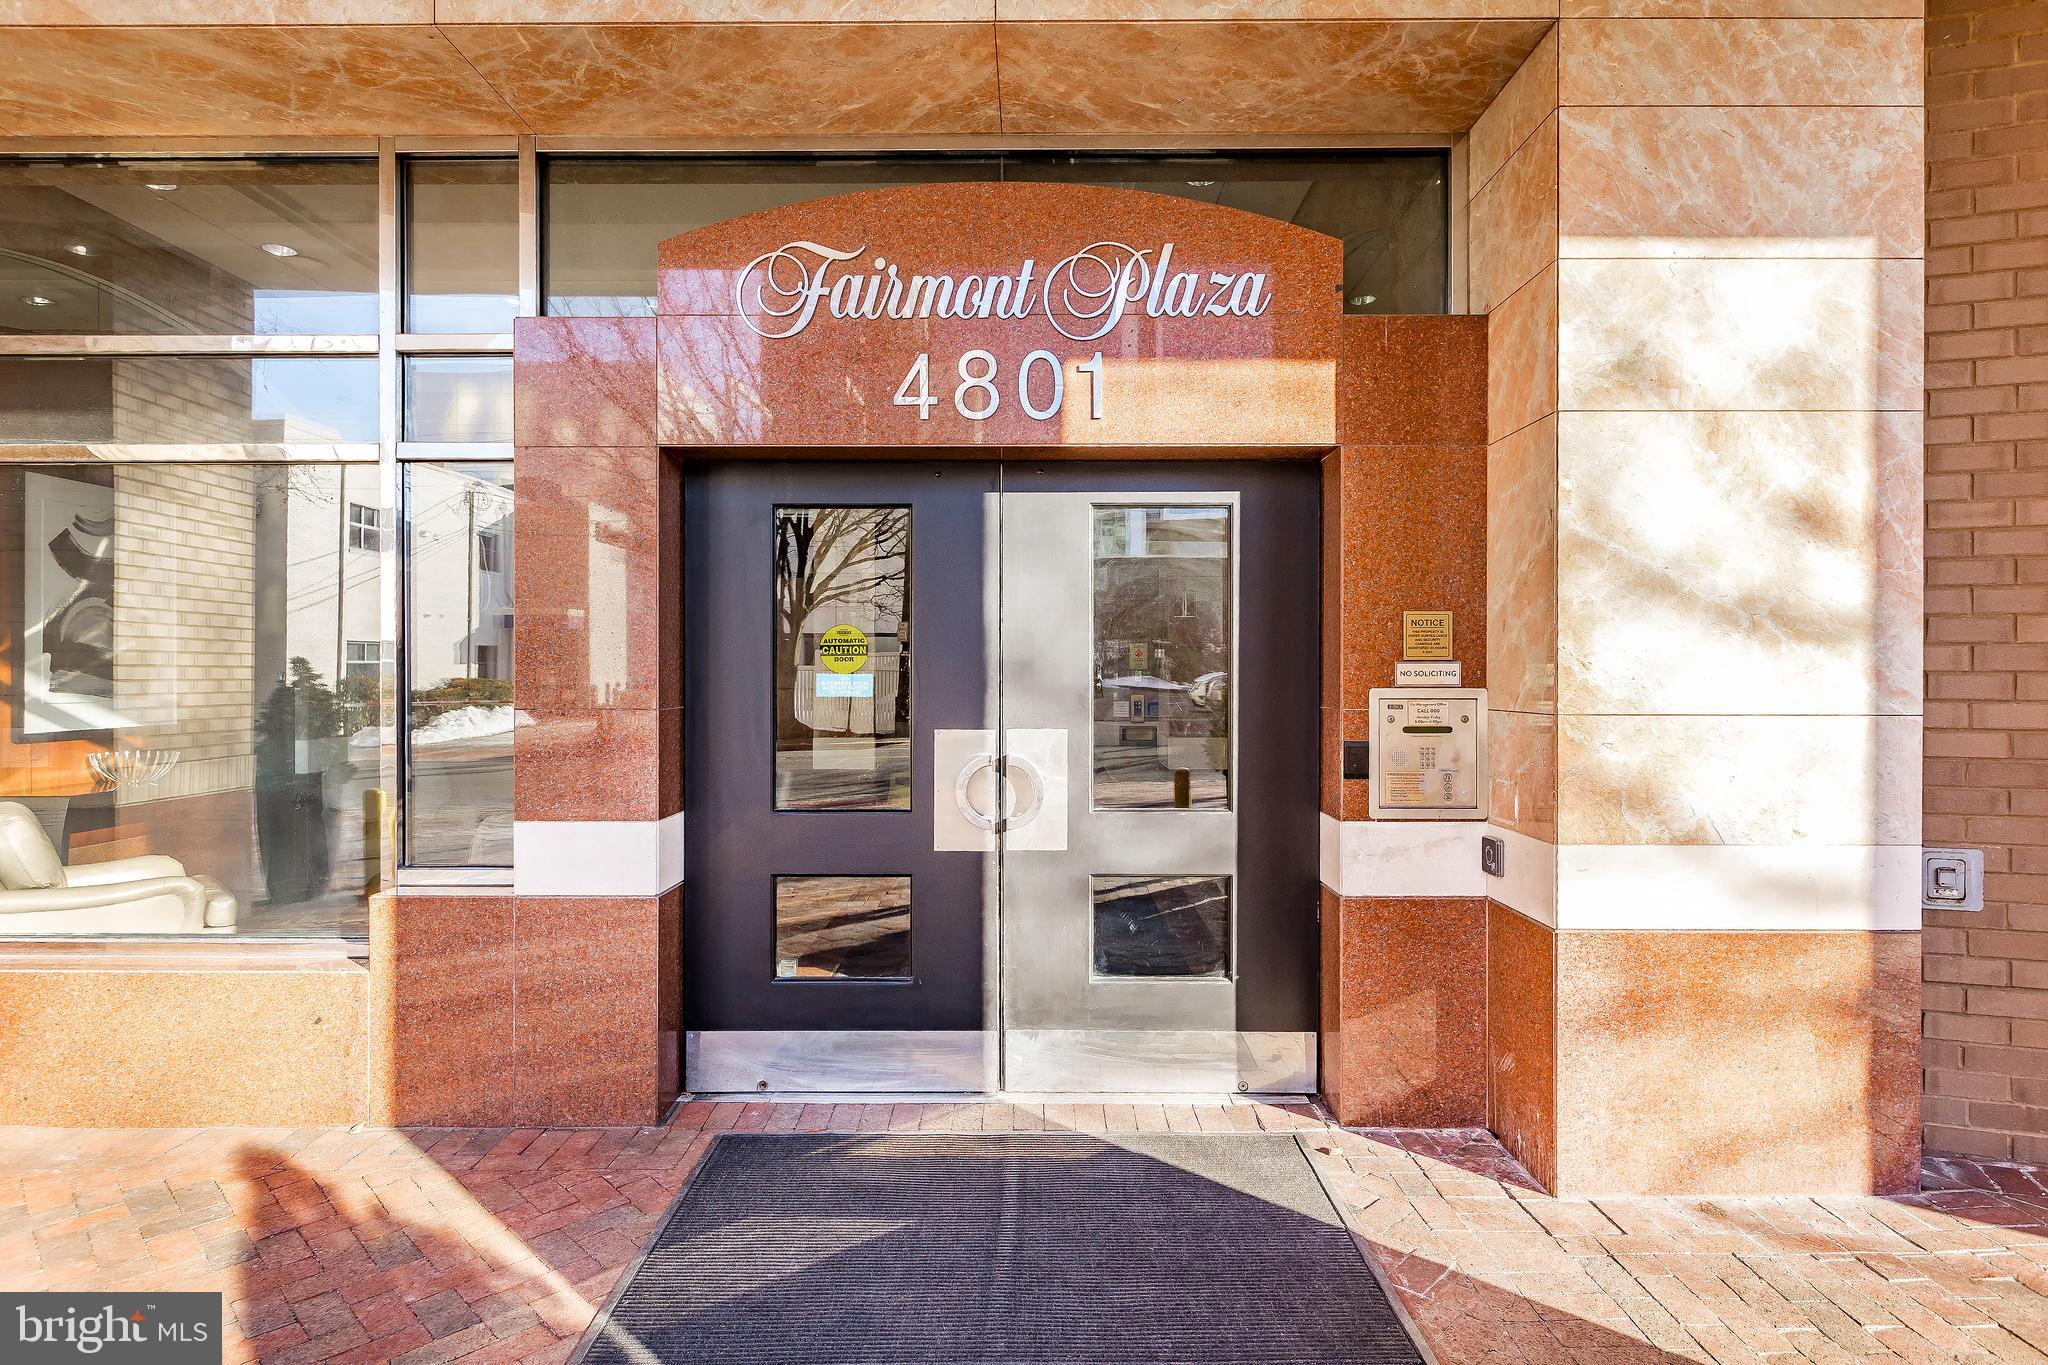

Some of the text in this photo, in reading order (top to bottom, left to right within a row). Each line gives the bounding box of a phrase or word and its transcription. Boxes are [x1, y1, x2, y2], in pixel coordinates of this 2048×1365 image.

[736, 240, 1272, 341] Fairmont Plaza
[893, 349, 1104, 421] 4801
[1411, 618, 1445, 626] NOTICE
[822, 646, 866, 654] CAUTION
